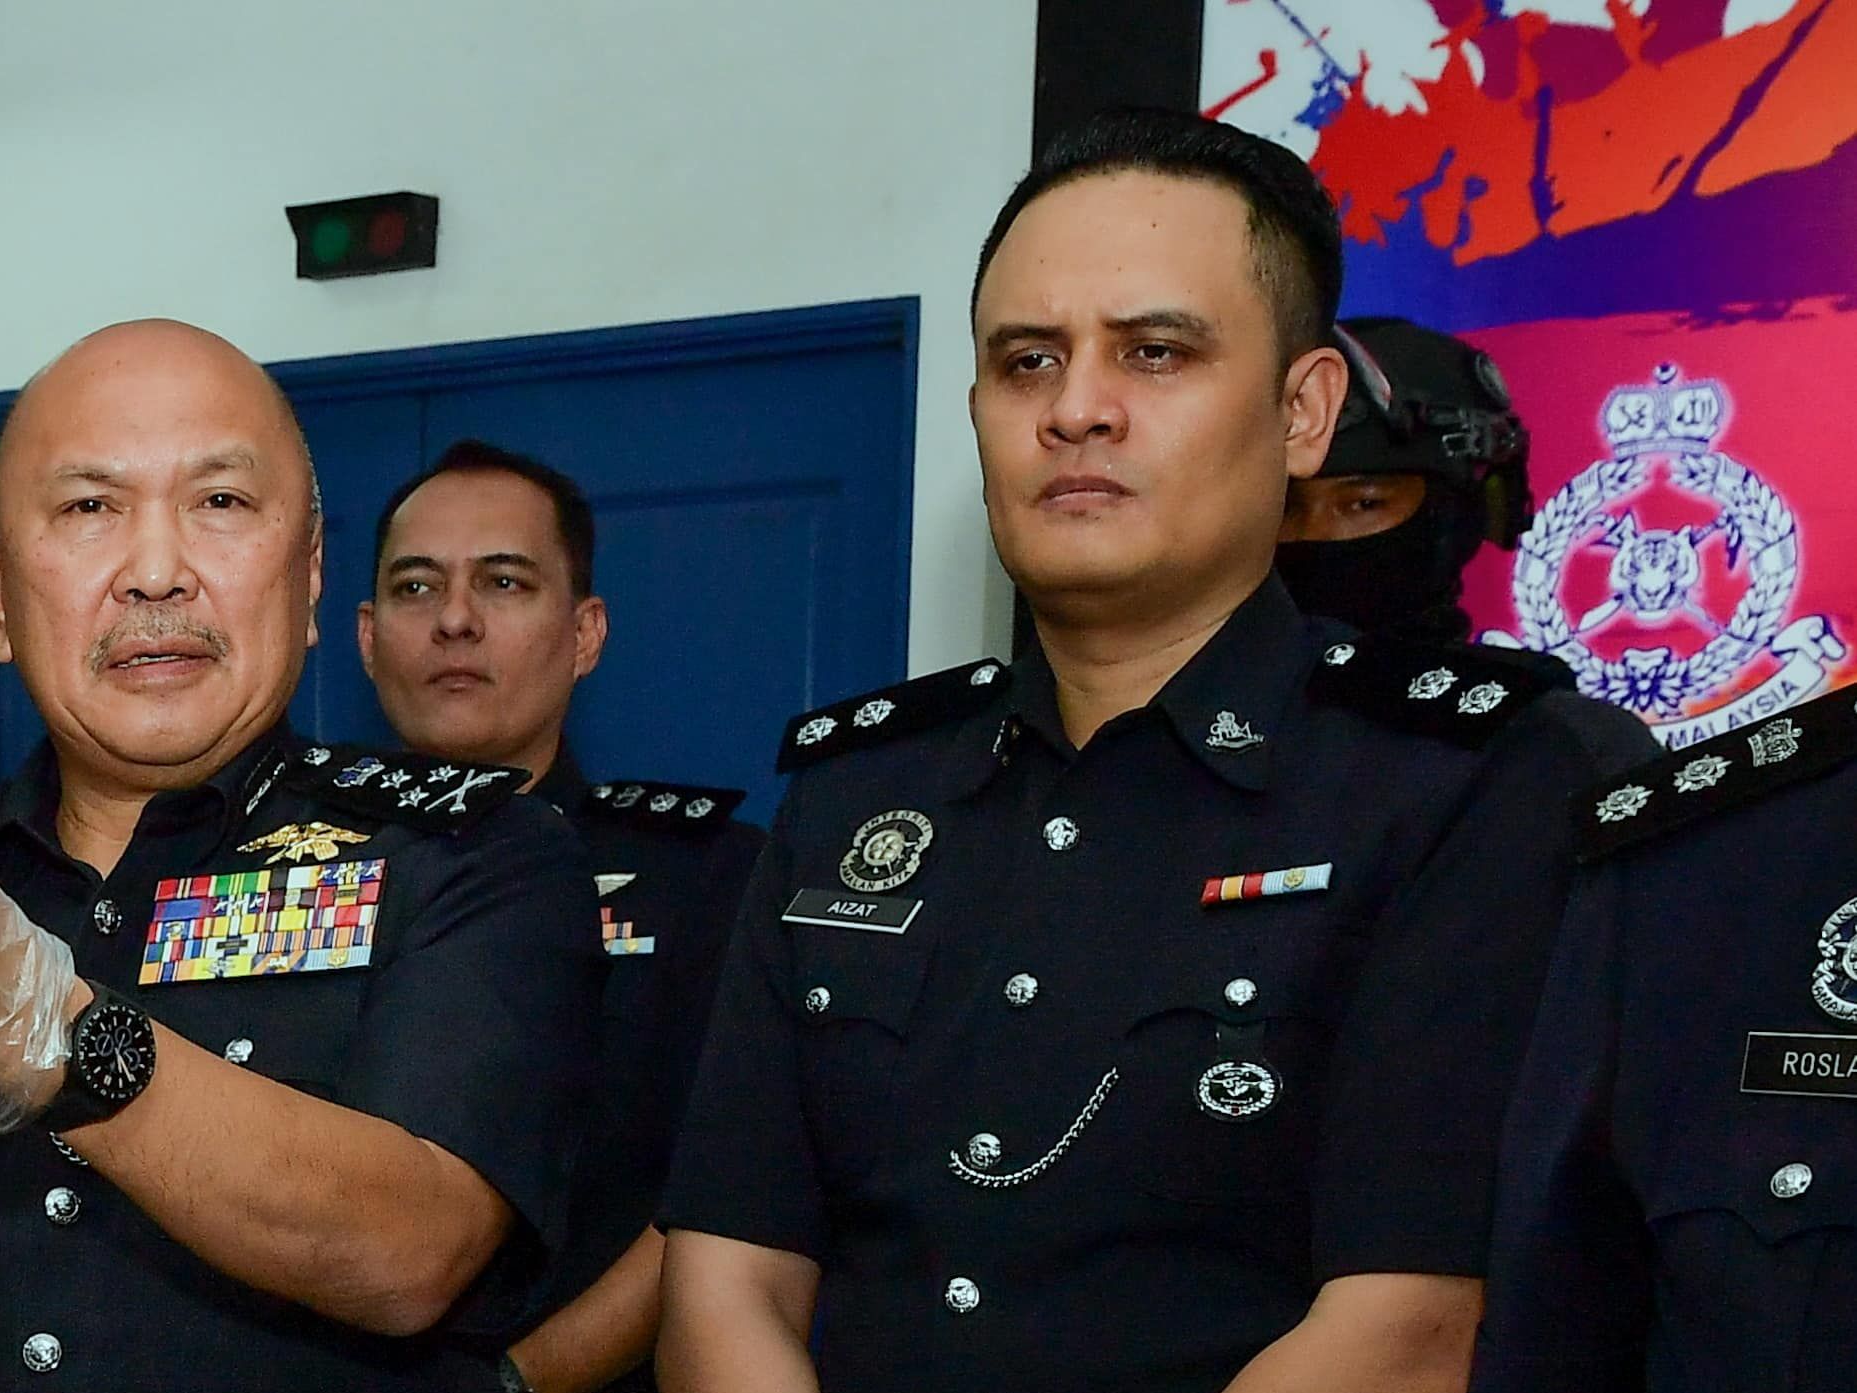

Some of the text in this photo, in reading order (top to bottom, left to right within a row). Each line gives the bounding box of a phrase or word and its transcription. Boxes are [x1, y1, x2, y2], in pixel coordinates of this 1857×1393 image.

[1666, 679, 1801, 749] MALAYSIA
[827, 900, 878, 918] AIZAT
[1783, 1051, 1857, 1078] ROSLA
